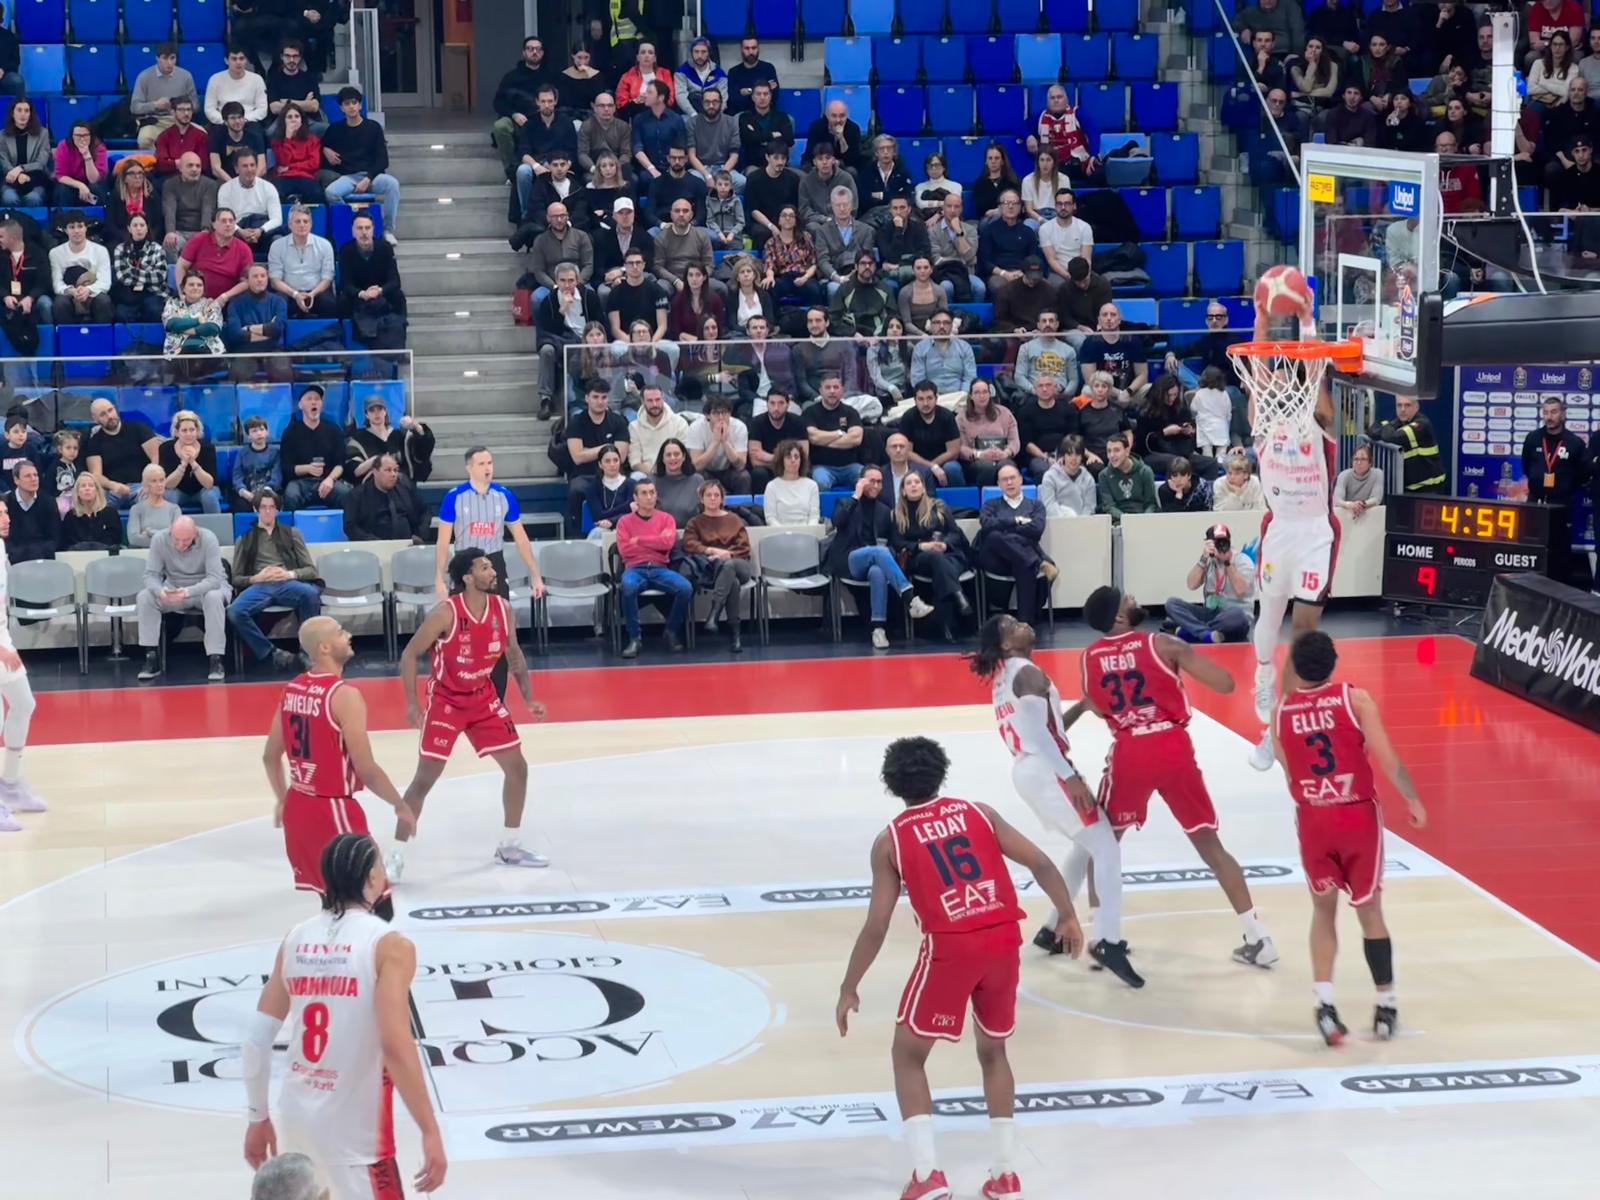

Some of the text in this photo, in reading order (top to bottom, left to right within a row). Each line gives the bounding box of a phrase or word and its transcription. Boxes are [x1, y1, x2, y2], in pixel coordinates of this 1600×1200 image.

[1394, 184, 1414, 209] Unipol
[1477, 371, 1501, 383] Unipol
[1542, 373, 1566, 384] Unipol
[1441, 505, 1516, 539] 4:59
[1397, 544, 1434, 559] HOME
[1453, 557, 1477, 568] PERIODS
[1494, 553, 1538, 568] GUEST
[1301, 571, 1320, 591] 15
[1417, 566, 1437, 596] 9
[459, 617, 470, 632] 12
[1100, 652, 1136, 673] NEBO
[1100, 670, 1155, 714] 32
[1292, 710, 1336, 735] ELLIS
[289, 715, 311, 760] 31
[1305, 732, 1337, 777] 3
[1299, 773, 1355, 798] EA7
[940, 802, 968, 817] AON
[912, 813, 968, 844] LEDAY
[926, 834, 984, 888] 16
[420, 902, 599, 918] EYEWEAR
[940, 879, 996, 917] EA7
[302, 1002, 329, 1064] 8
[1356, 1070, 1569, 1090] EYEWEAR
[1181, 1082, 1314, 1105] EA7
[502, 1115, 723, 1139] EYEWEAR
[750, 1102, 888, 1130] EA7
